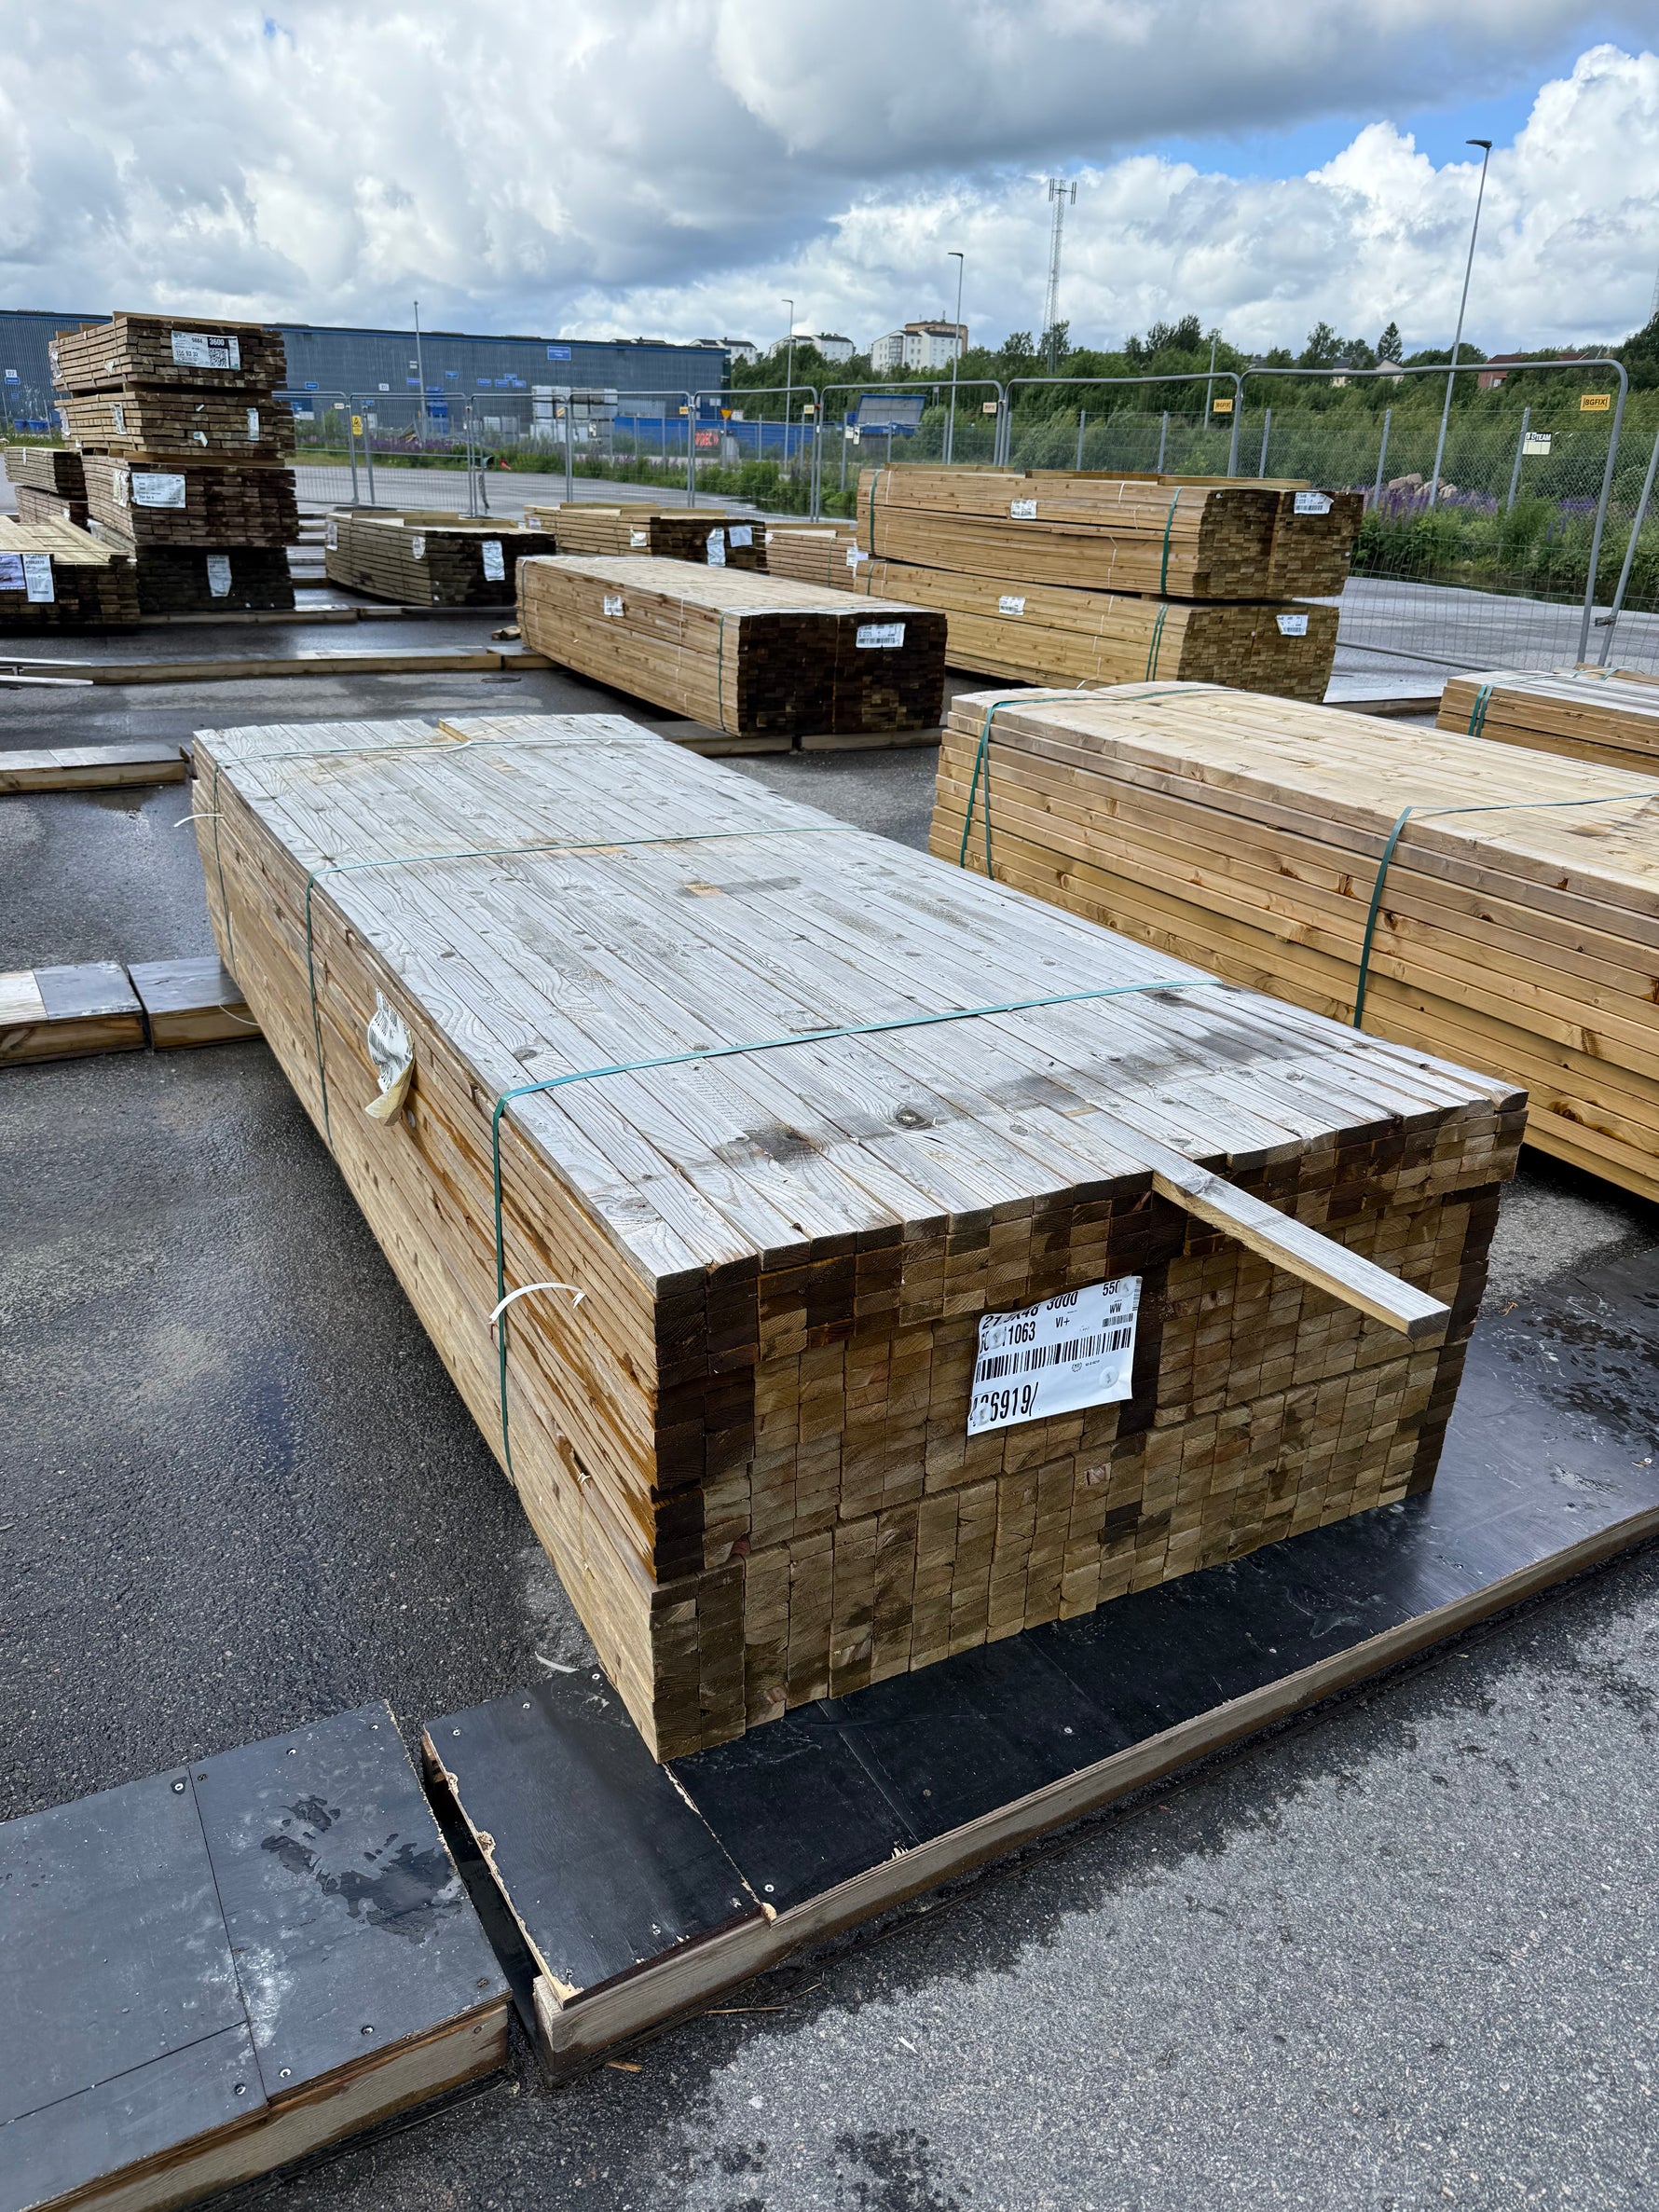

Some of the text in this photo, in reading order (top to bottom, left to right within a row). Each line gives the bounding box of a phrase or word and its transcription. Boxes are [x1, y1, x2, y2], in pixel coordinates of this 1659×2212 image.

[1046, 1291, 1079, 1311] 3000
[1109, 1302, 1122, 1314] WW
[1055, 1316, 1070, 1328] VI+
